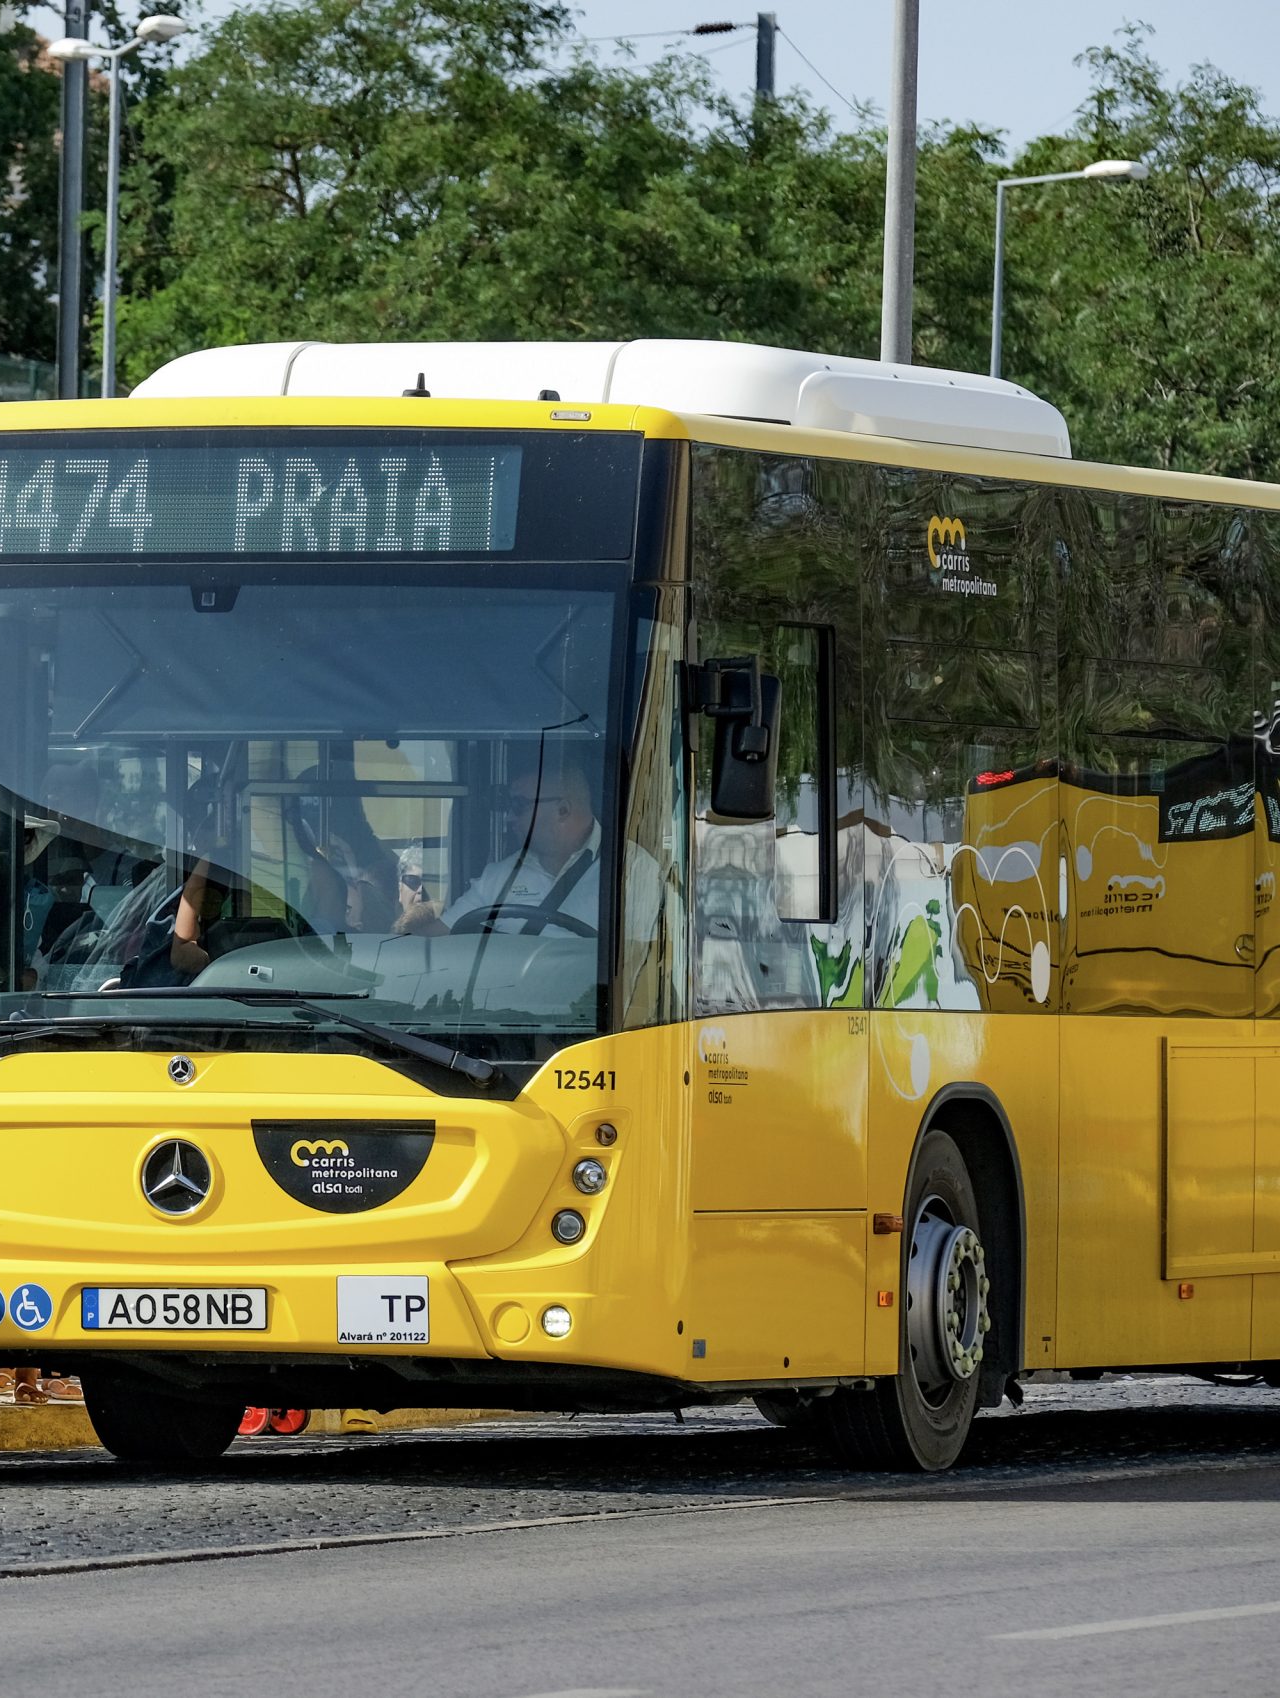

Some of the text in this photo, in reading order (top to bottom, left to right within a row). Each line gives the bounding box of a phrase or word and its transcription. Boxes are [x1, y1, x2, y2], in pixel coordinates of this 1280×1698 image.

[234, 457, 452, 552] PRAIA
[941, 553, 970, 572] carris
[942, 576, 997, 598] metropolitana
[847, 1015, 868, 1035] 12541
[708, 1052, 729, 1065] carris
[554, 1069, 616, 1091] 12541
[708, 1067, 749, 1082] metropolitana
[708, 1090, 723, 1104] alsa
[311, 1157, 355, 1168] carris
[311, 1168, 398, 1180] metropolitana
[312, 1182, 342, 1194] alsa
[87, 1293, 253, 1325] P AO58NB
[380, 1295, 426, 1323] TP
[339, 1332, 373, 1341] Alvará
[390, 1332, 426, 1341] 201122
